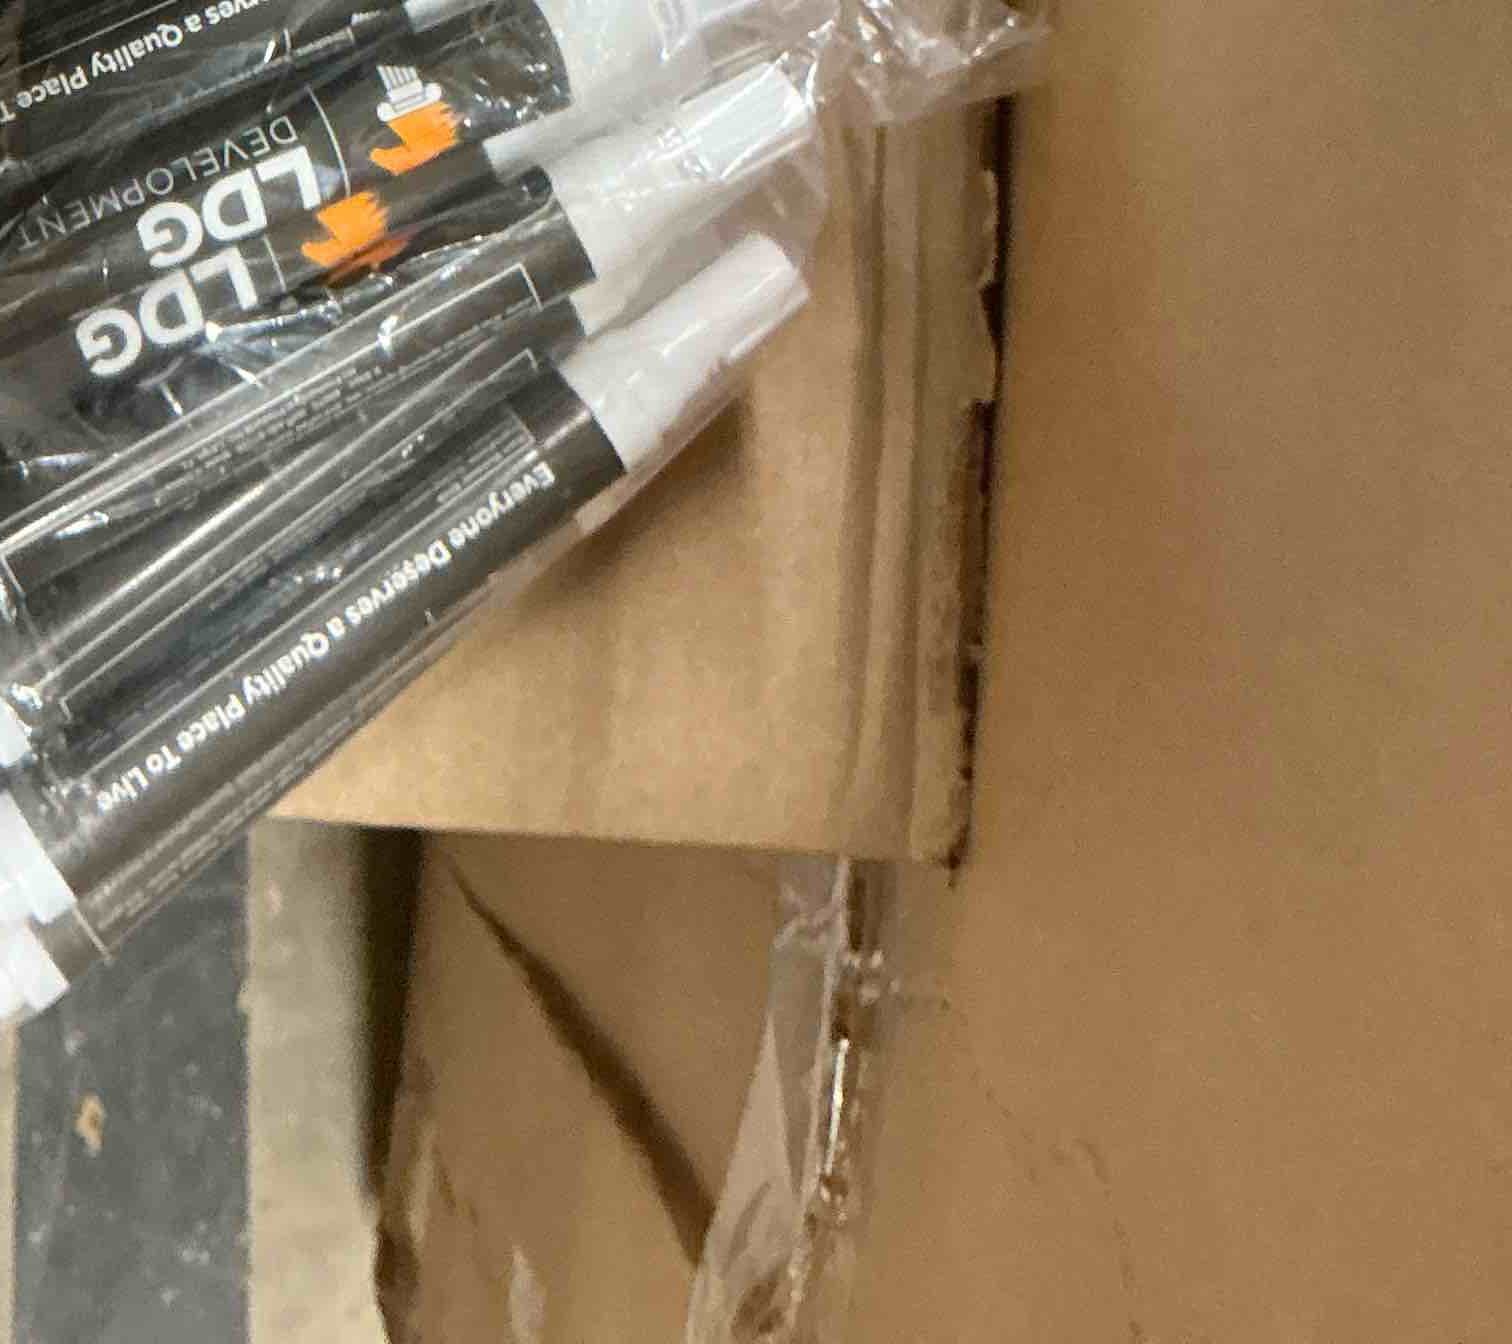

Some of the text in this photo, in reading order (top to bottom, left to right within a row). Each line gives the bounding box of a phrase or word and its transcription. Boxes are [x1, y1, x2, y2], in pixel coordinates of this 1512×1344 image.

[90, 22, 185, 79] Quality
[184, 13, 202, 34] a
[15, 69, 86, 109] Place
[16, 115, 298, 251] DEVELOPMENT
[137, 144, 322, 269] LDG
[75, 247, 258, 378] LDG
[448, 461, 556, 551] Everyone
[345, 539, 453, 627] Deserves
[325, 615, 347, 640] a
[242, 630, 330, 706] Quality
[177, 693, 246, 753] Place
[97, 765, 151, 812] Live
[145, 744, 182, 774] To
